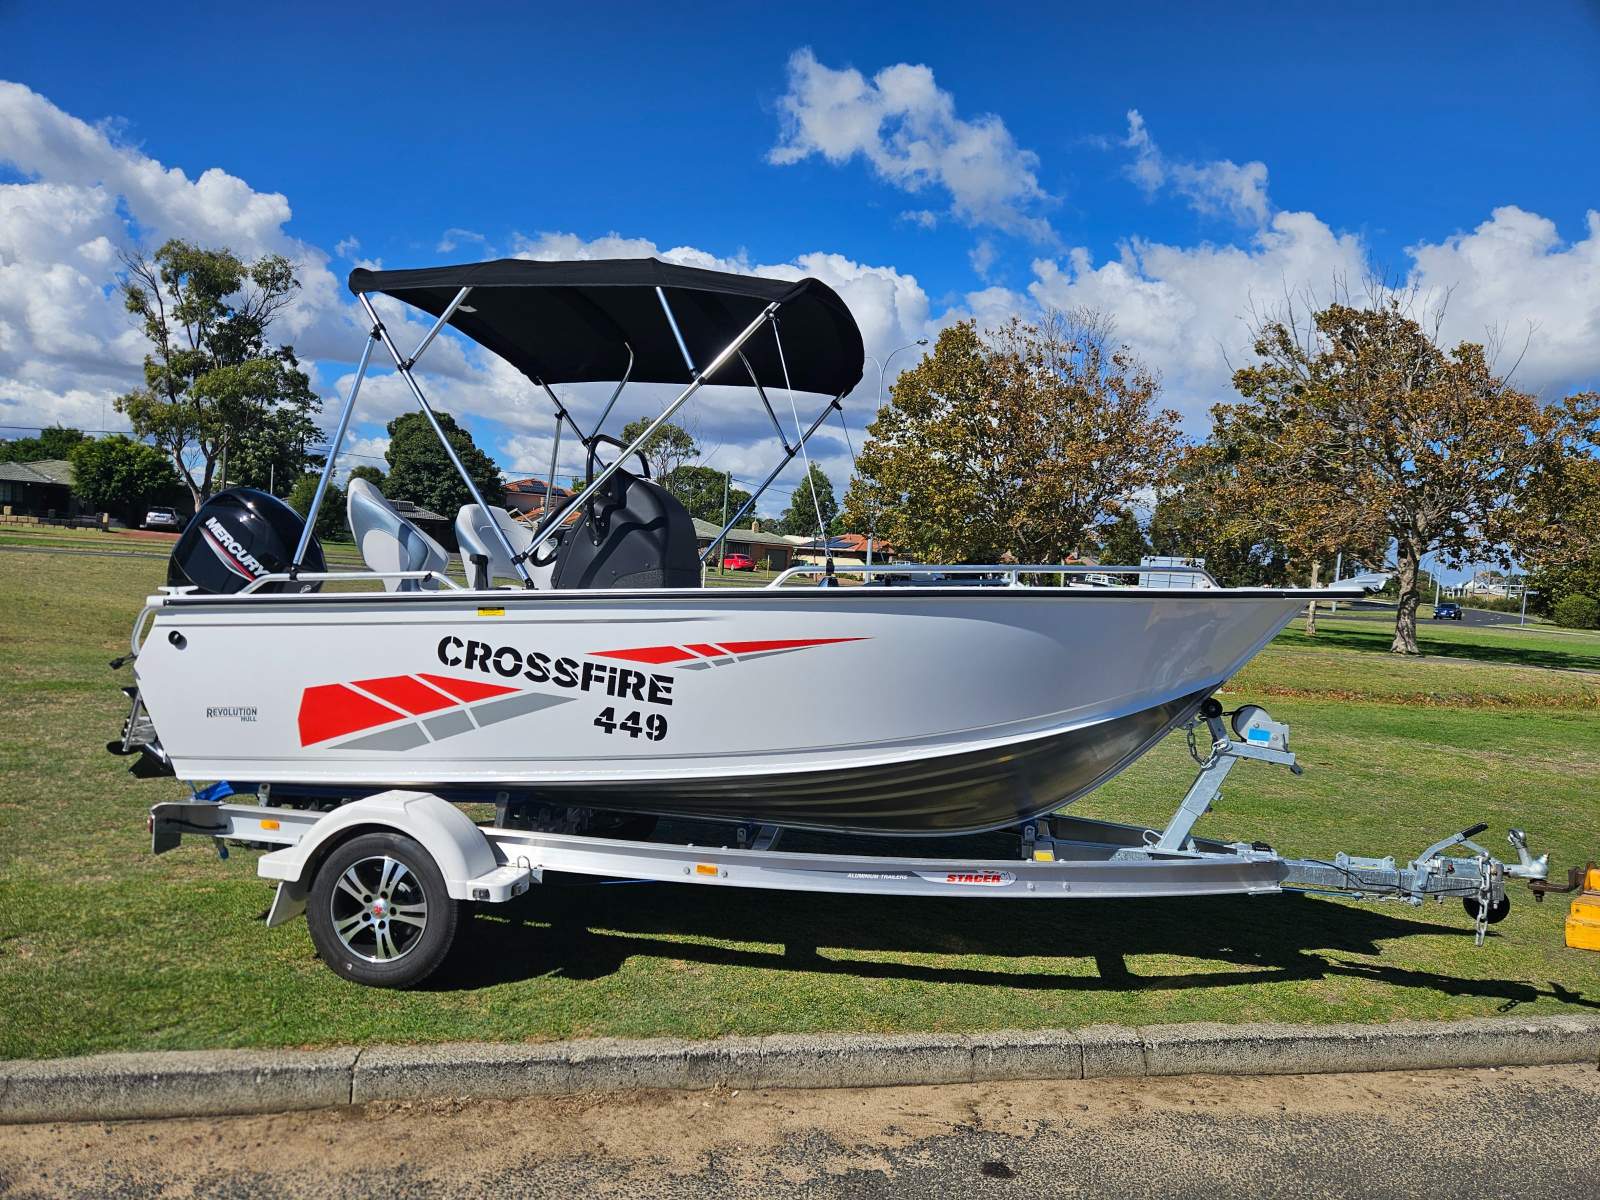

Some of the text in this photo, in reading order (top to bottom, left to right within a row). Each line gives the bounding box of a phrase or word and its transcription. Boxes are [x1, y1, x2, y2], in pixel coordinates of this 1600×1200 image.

[205, 516, 271, 577] MERCURY
[206, 706, 257, 718] REVOLUTION
[593, 706, 668, 741] 449
